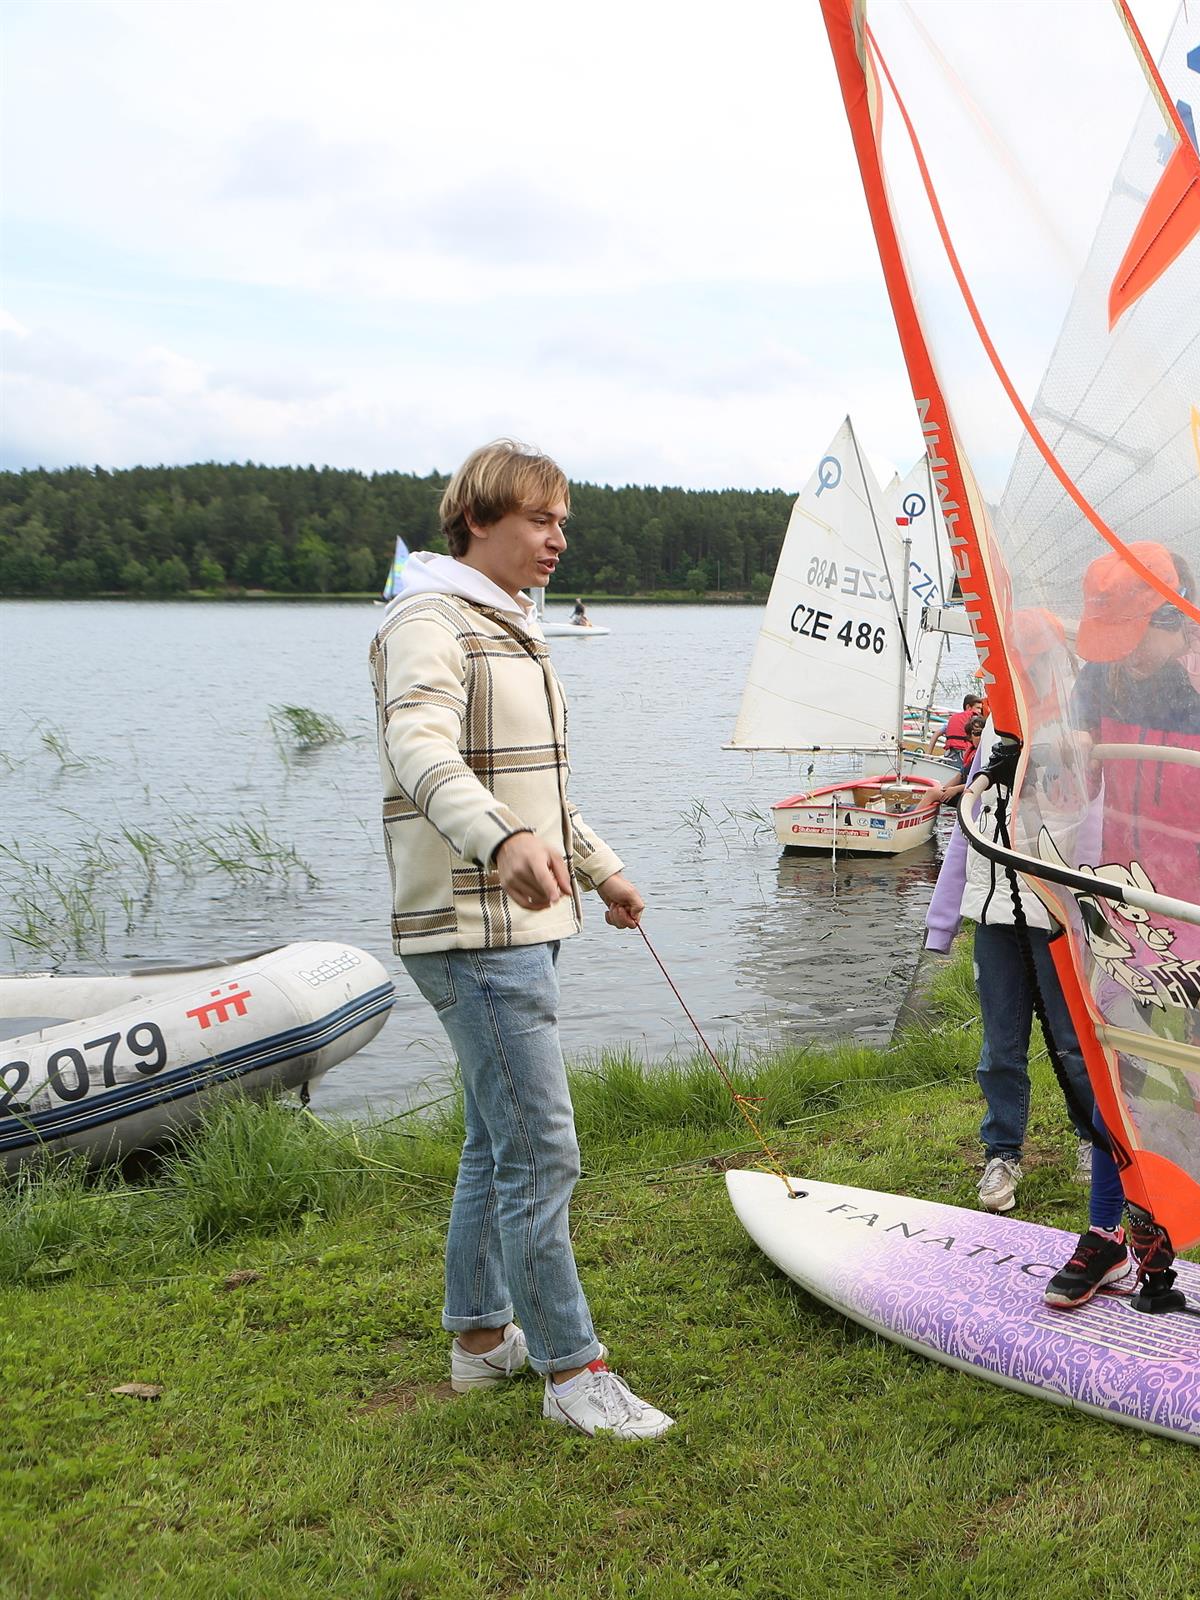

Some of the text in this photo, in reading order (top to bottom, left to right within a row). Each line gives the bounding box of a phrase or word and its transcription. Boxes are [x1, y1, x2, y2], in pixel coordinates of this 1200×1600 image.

[790, 603, 886, 654] CZE 486
[826, 1203, 1059, 1278] FANATIC
